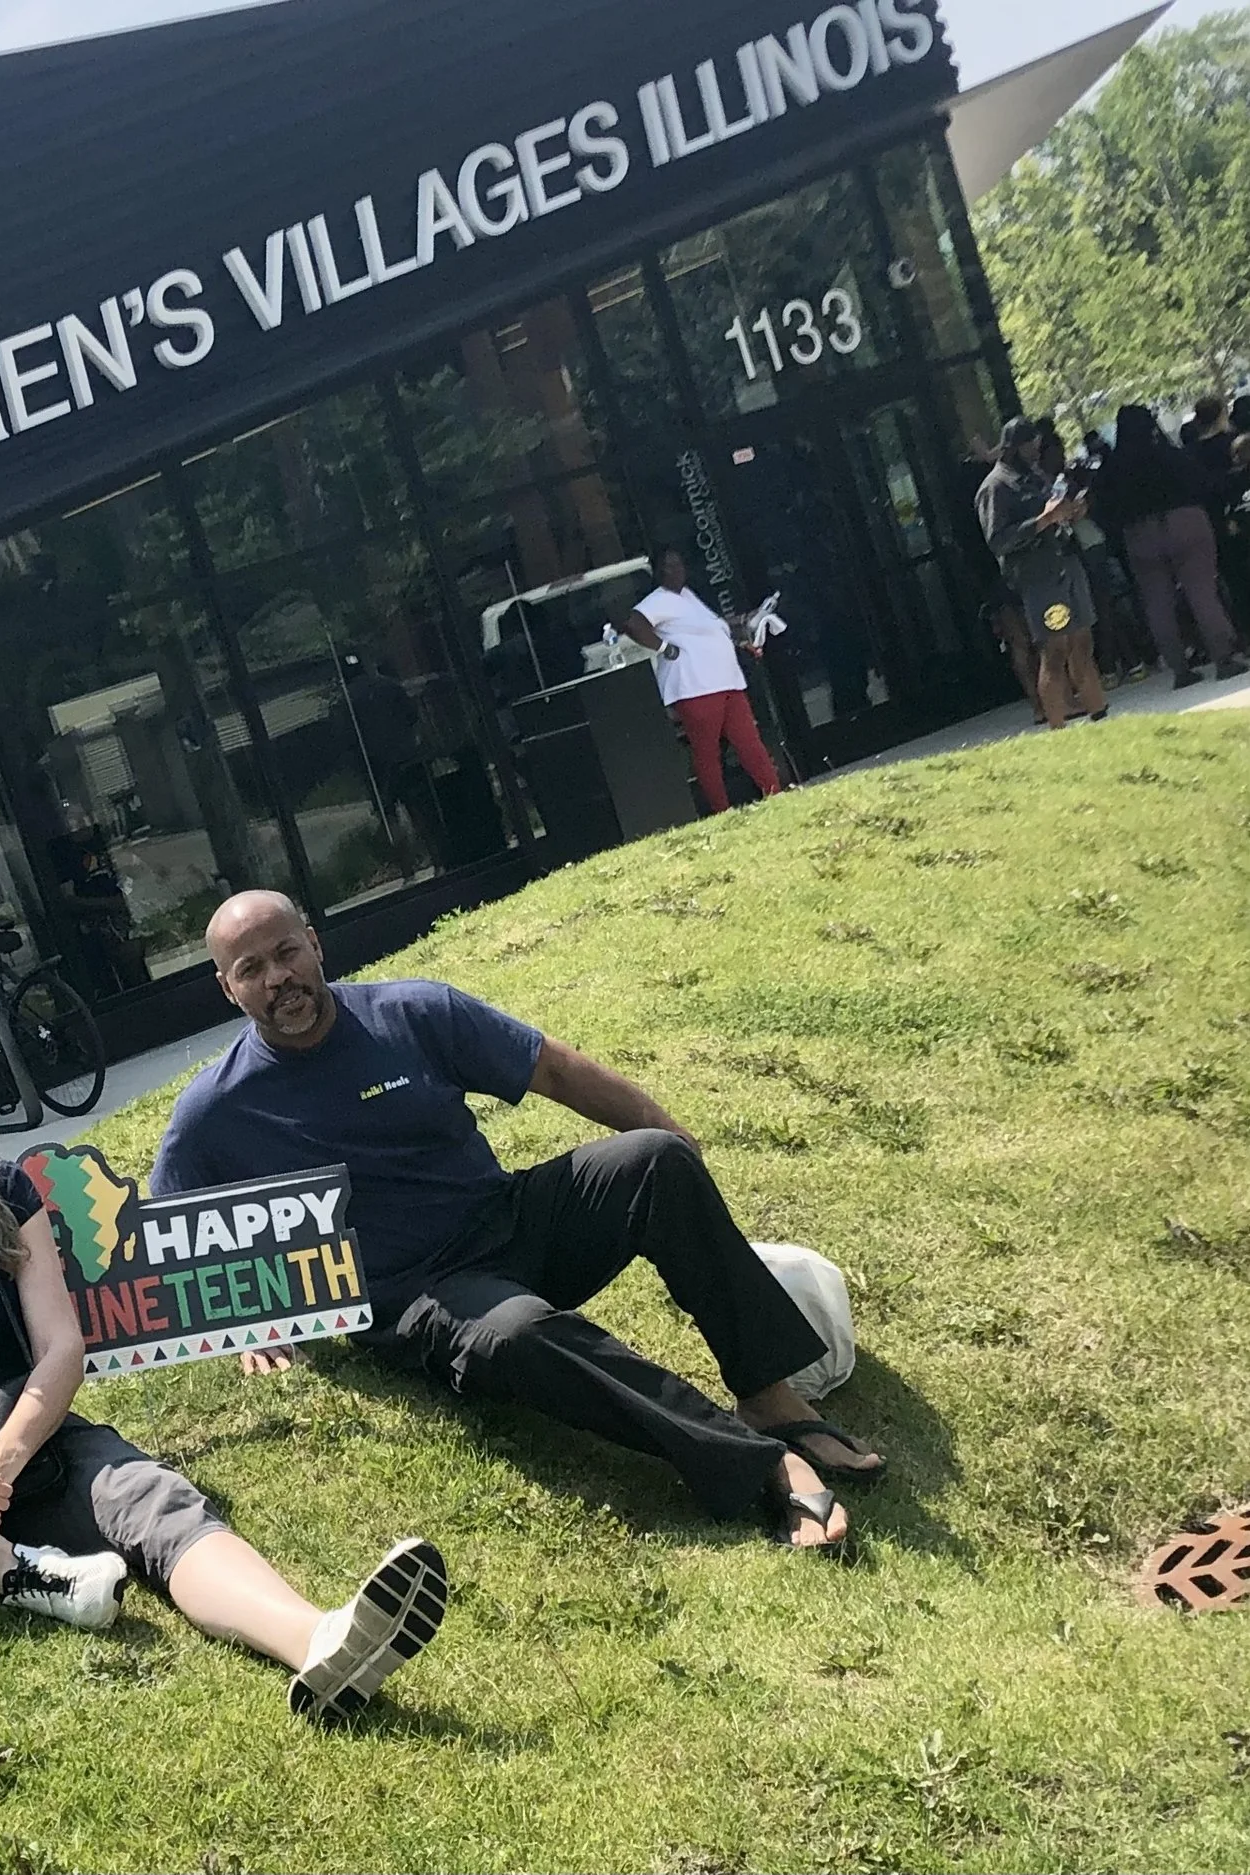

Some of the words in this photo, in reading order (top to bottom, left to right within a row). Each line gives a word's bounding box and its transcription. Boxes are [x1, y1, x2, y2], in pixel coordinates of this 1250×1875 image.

[223, 101, 630, 331] VILLAGES
[638, 0, 935, 167] ILLINOIS
[725, 287, 863, 381] 1133
[360, 1083, 383, 1100] Reiki
[384, 1076, 410, 1091] Heals
[143, 1188, 342, 1265] HAPPY
[68, 1240, 361, 1345] UNETEENTH
